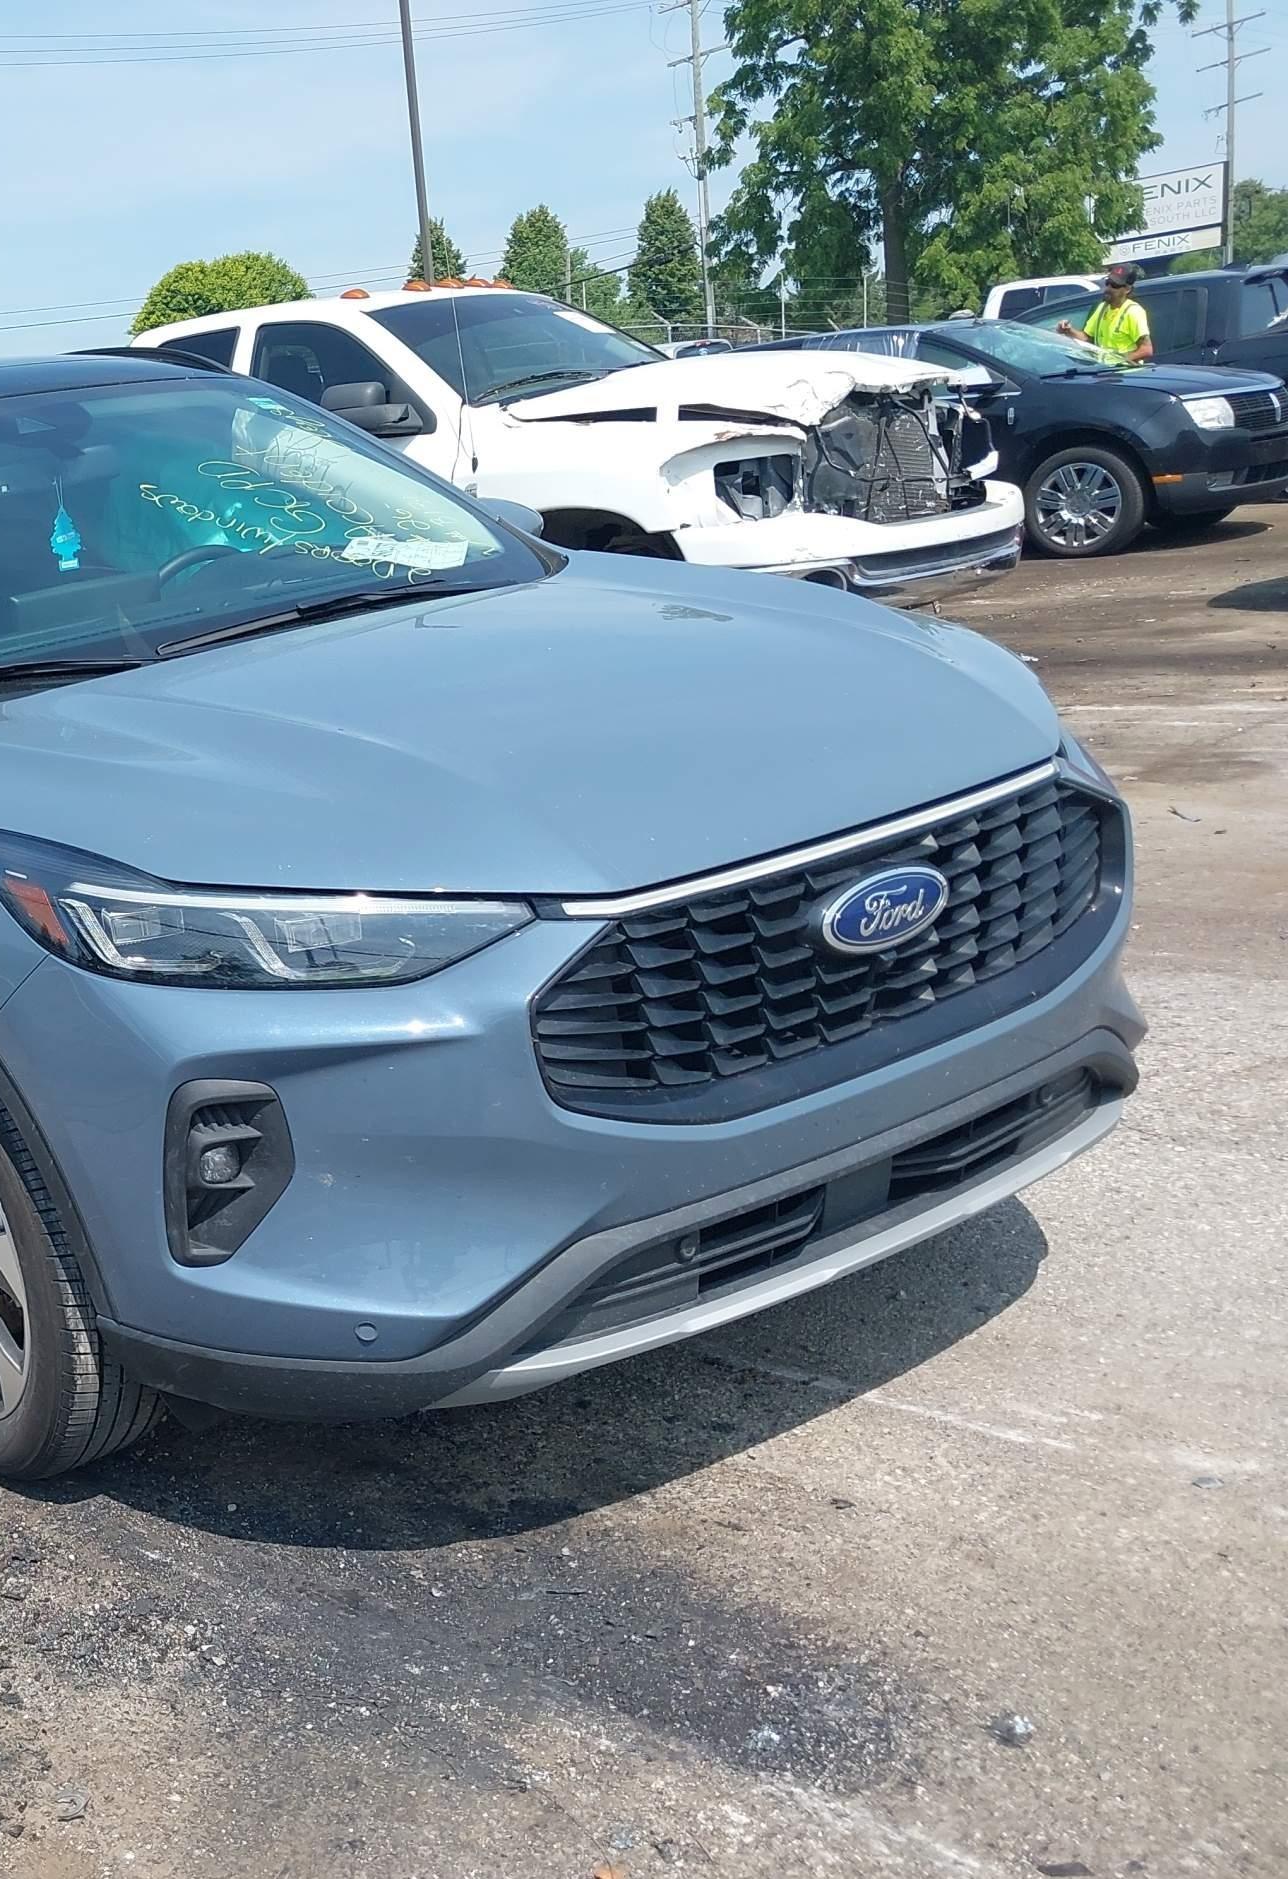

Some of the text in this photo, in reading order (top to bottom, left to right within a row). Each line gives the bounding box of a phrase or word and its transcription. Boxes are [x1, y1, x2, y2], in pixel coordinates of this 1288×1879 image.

[1143, 174, 1213, 201] ENIX
[1146, 195, 1217, 217] ENIX PARTS
[1150, 206, 1217, 227] SOUTH LLC
[1132, 234, 1190, 253] FENIX
[859, 884, 925, 937] Ford
